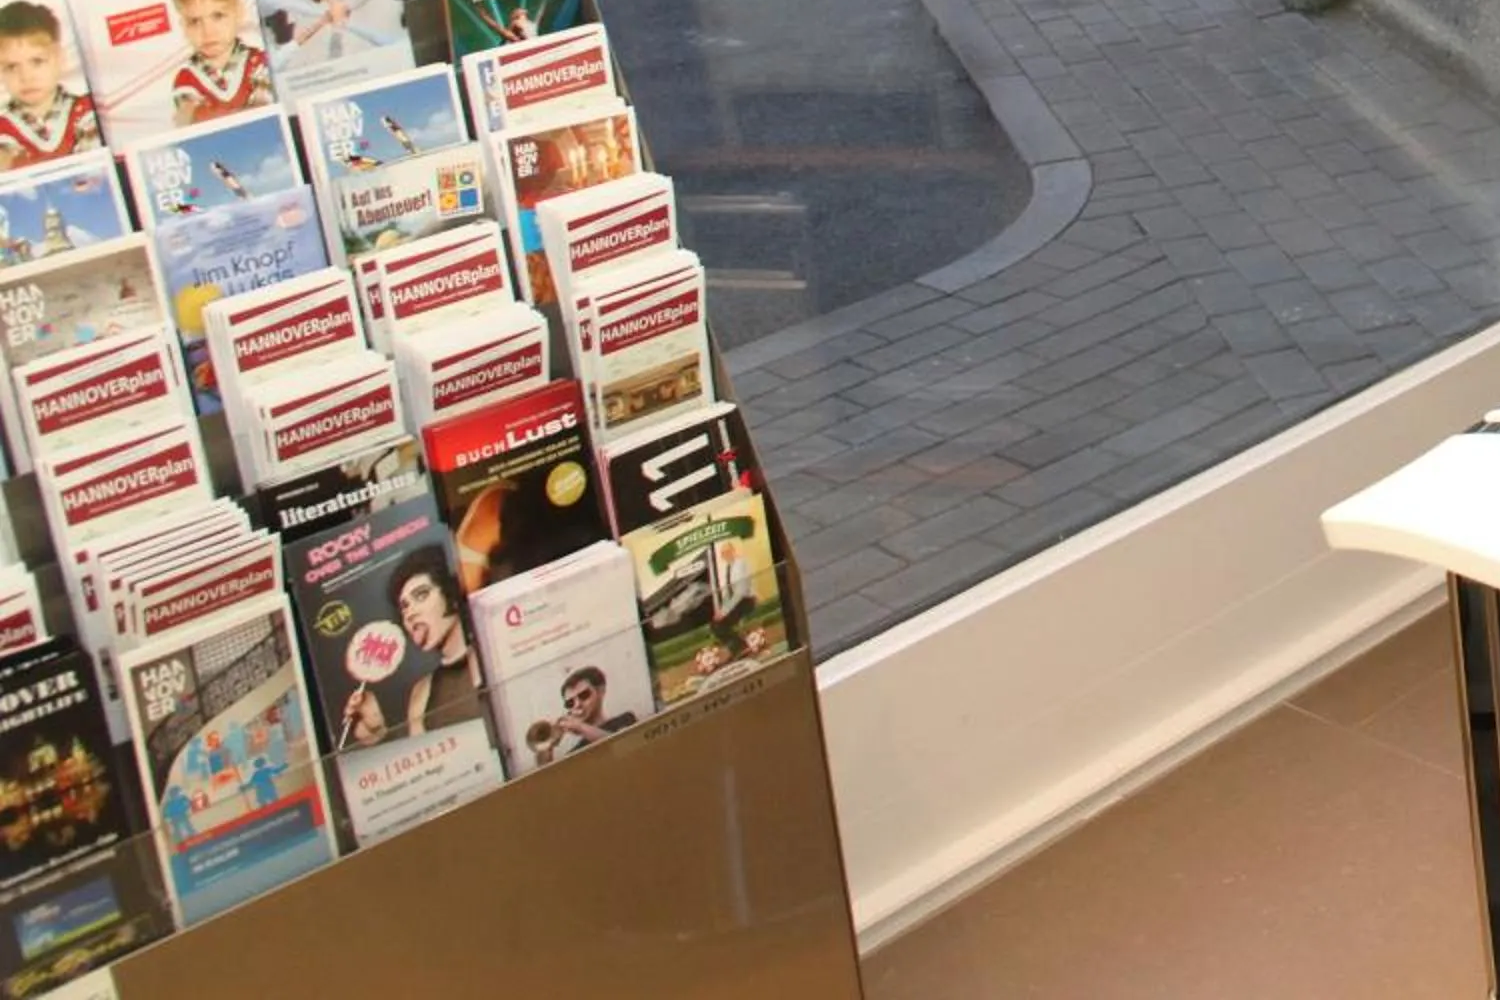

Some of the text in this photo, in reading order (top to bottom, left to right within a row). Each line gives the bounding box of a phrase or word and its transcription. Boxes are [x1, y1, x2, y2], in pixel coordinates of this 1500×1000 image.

[503, 59, 604, 96] HANNOVERplan
[569, 216, 670, 259] HANNOVERplan
[191, 260, 229, 289] Jim
[230, 239, 298, 276] Knopf
[390, 262, 501, 306] HANNOVERplan
[235, 310, 352, 357] HANNOVERplan
[600, 300, 699, 343] HANNOVERplan
[34, 367, 165, 421] HANNOVERplan
[433, 352, 543, 399] HANNOVERplan
[275, 397, 394, 449] HANNOVERplan
[62, 456, 195, 510] HANNOVERplan
[278, 468, 418, 529] literaturhaus
[307, 522, 370, 567] ROCKY
[144, 565, 274, 624] HANNOVERplan
